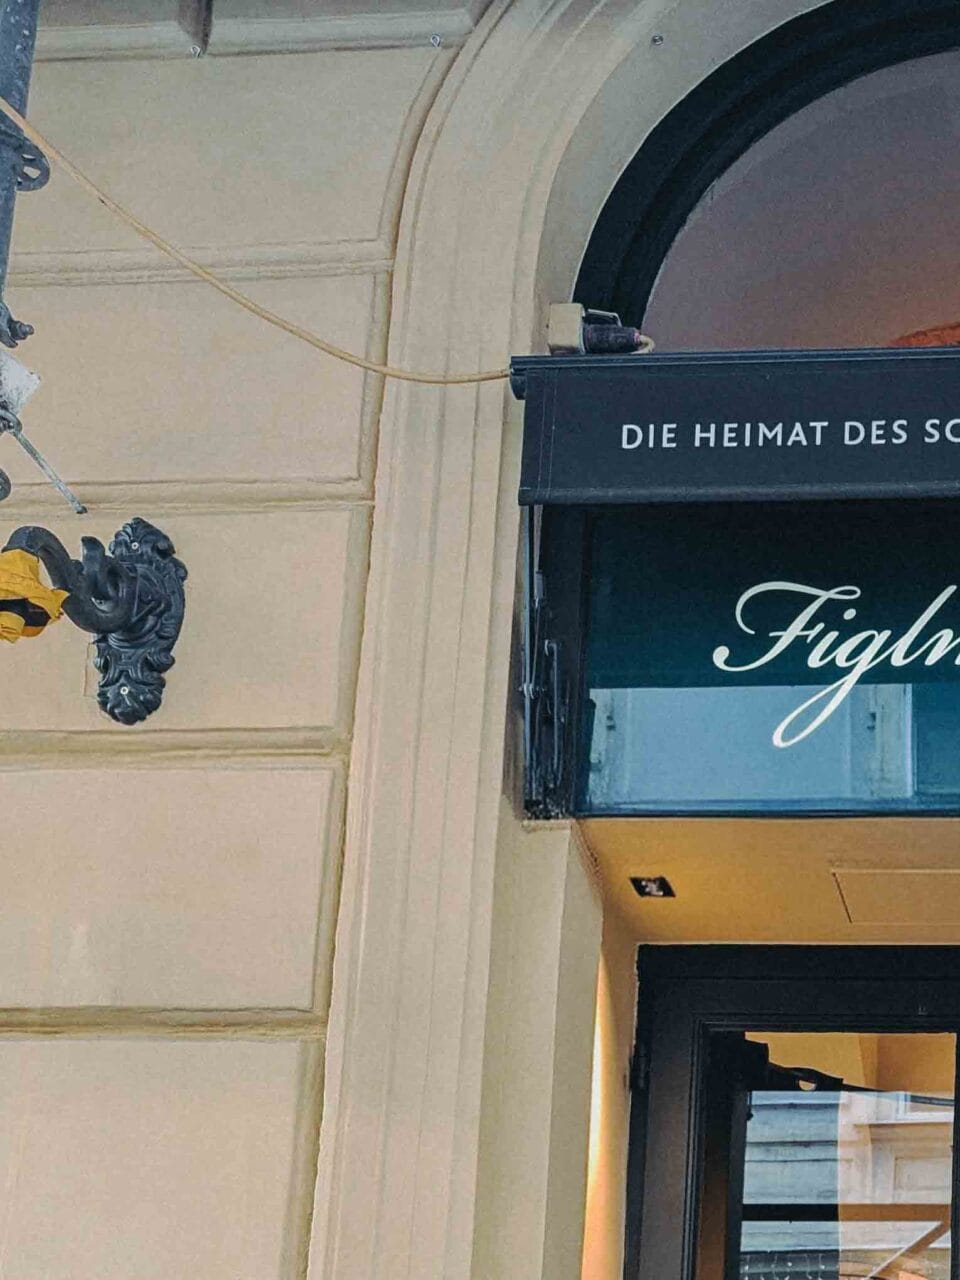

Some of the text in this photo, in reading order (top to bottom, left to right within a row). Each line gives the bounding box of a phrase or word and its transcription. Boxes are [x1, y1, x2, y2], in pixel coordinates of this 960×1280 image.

[621, 423, 678, 449] DIE
[693, 420, 829, 448] HEIMAT
[844, 419, 908, 446] DES
